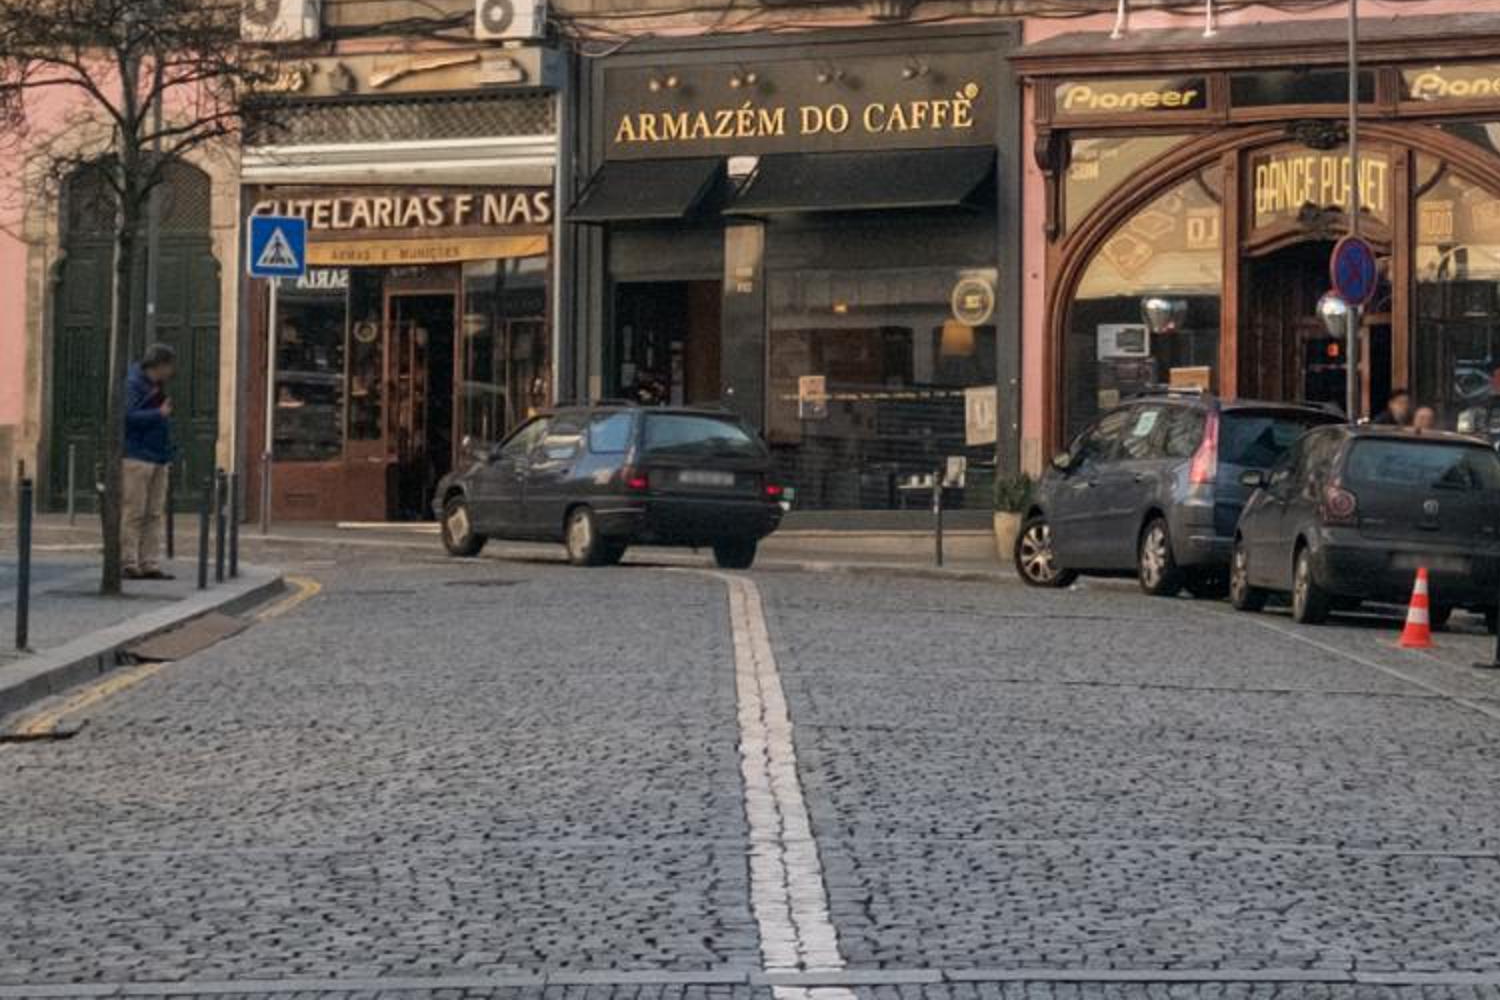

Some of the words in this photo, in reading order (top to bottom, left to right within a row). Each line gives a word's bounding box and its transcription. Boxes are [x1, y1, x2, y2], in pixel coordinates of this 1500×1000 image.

[1063, 85, 1198, 109] Pioneer
[615, 101, 785, 142] ARMAZÉM
[800, 103, 849, 133] DO
[1256, 156, 1316, 213] DANCE
